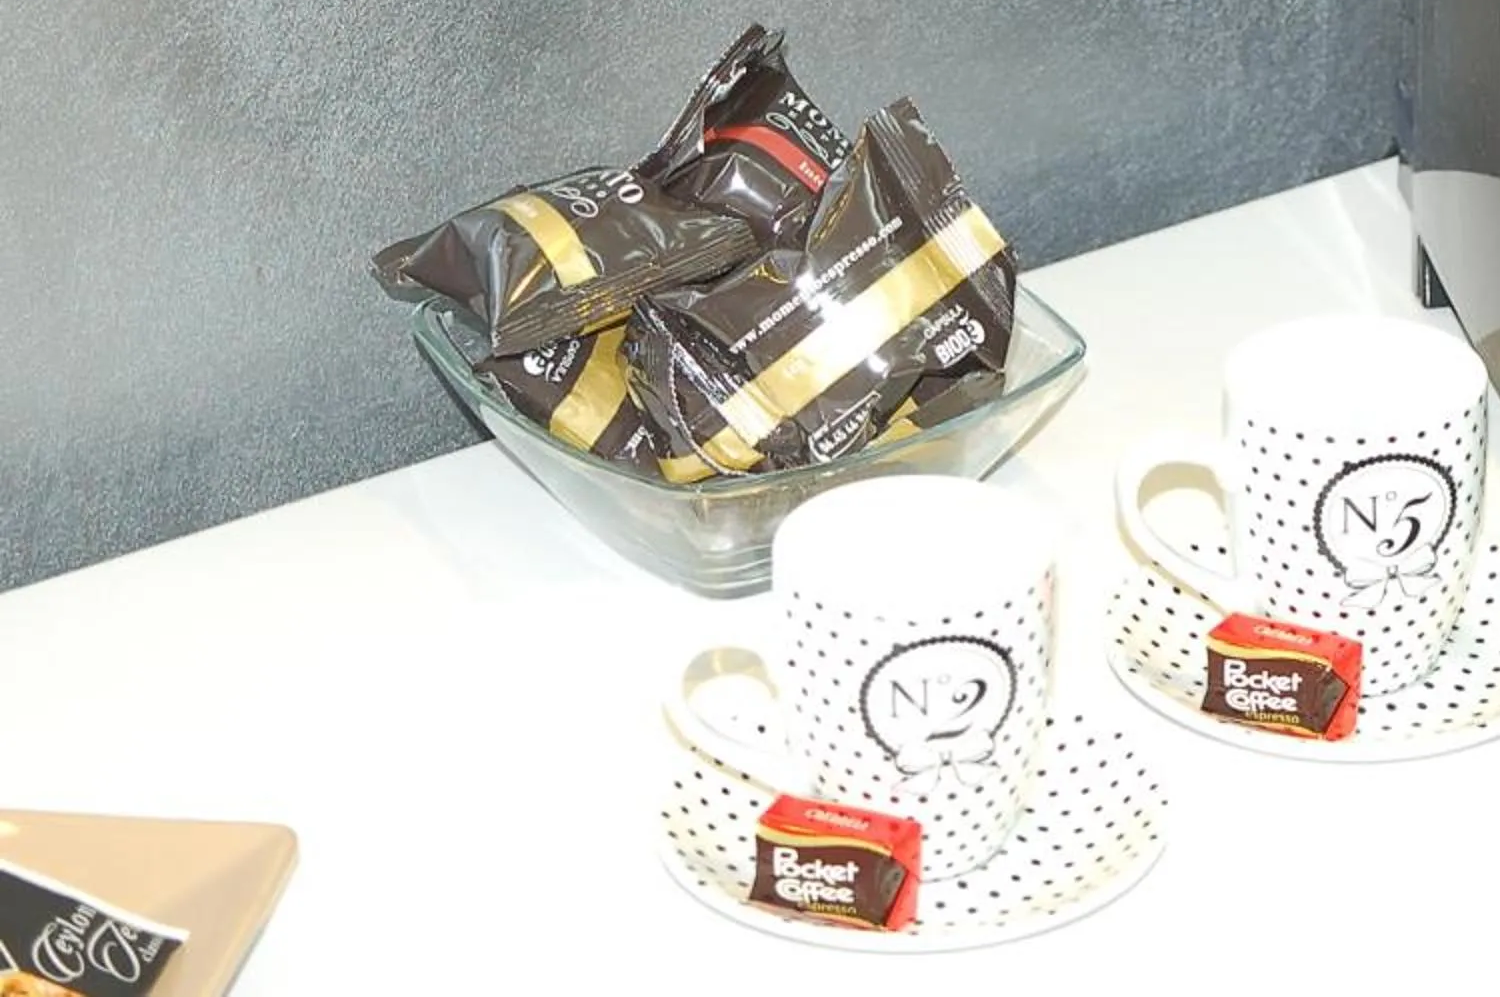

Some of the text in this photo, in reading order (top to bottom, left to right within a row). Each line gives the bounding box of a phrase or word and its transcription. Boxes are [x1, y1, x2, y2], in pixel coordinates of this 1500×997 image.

[1223, 658, 1304, 695] Pocket
[1224, 687, 1299, 713] Coffee
[773, 846, 860, 886] Pocket
[775, 877, 855, 905] Coffee
[31, 904, 97, 983] Ceylon
[87, 918, 142, 983] Te
